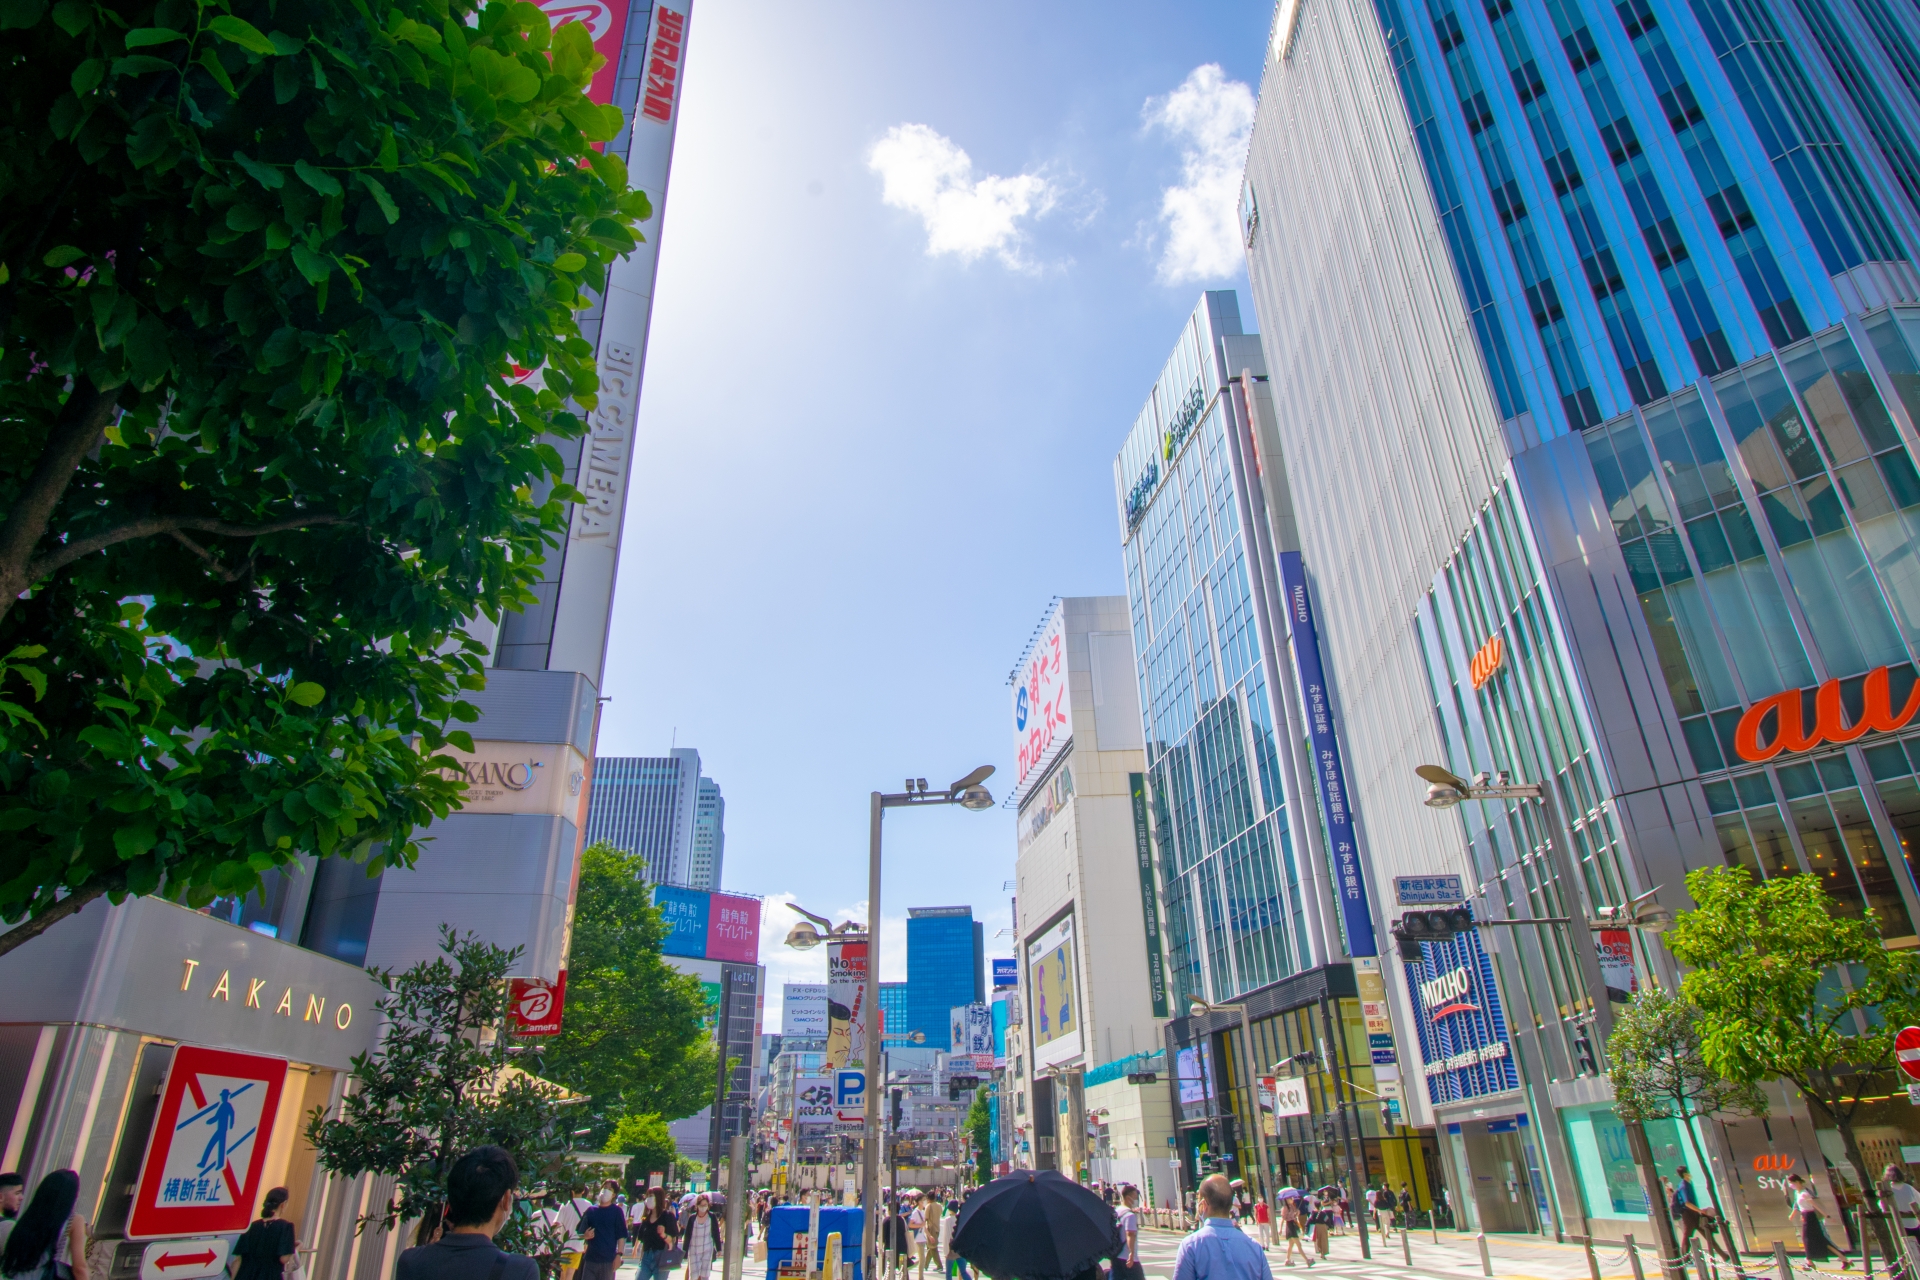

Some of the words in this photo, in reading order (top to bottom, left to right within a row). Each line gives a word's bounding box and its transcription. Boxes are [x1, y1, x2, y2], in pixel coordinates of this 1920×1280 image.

[600, 340, 636, 398] BIC
[578, 399, 630, 540] CAMERA
[1293, 584, 1308, 623] MIZUHO
[1470, 635, 1501, 691] au
[1309, 684, 1328, 734] みずほ証券
[1734, 665, 1920, 763] au
[1018, 681, 1067, 785] かねふく
[438, 761, 534, 792] AKANO
[1321, 750, 1345, 825] みずほ信託銀行
[1137, 823, 1149, 868] 三井住友銀行
[1338, 842, 1360, 899] みずほ銀行
[1399, 878, 1460, 891] 新宿駅東口
[667, 901, 698, 918] 龍角散
[1400, 891, 1435, 902] Shinjuku
[1437, 890, 1462, 899] Sta.-E
[716, 923, 753, 940] ダイレクト
[720, 908, 749, 925] 龍角散
[829, 957, 849, 969] No
[830, 969, 866, 979] Smoking
[180, 958, 353, 1030] TAKANO
[1421, 966, 1469, 1011] MIZUHO
[972, 1034, 994, 1053] 鉄人
[800, 1085, 833, 1106] くら
[838, 1072, 865, 1105] P
[799, 1106, 833, 1116] KURA
[1753, 1153, 1795, 1171] au
[163, 1178, 221, 1202] 横断禁止
